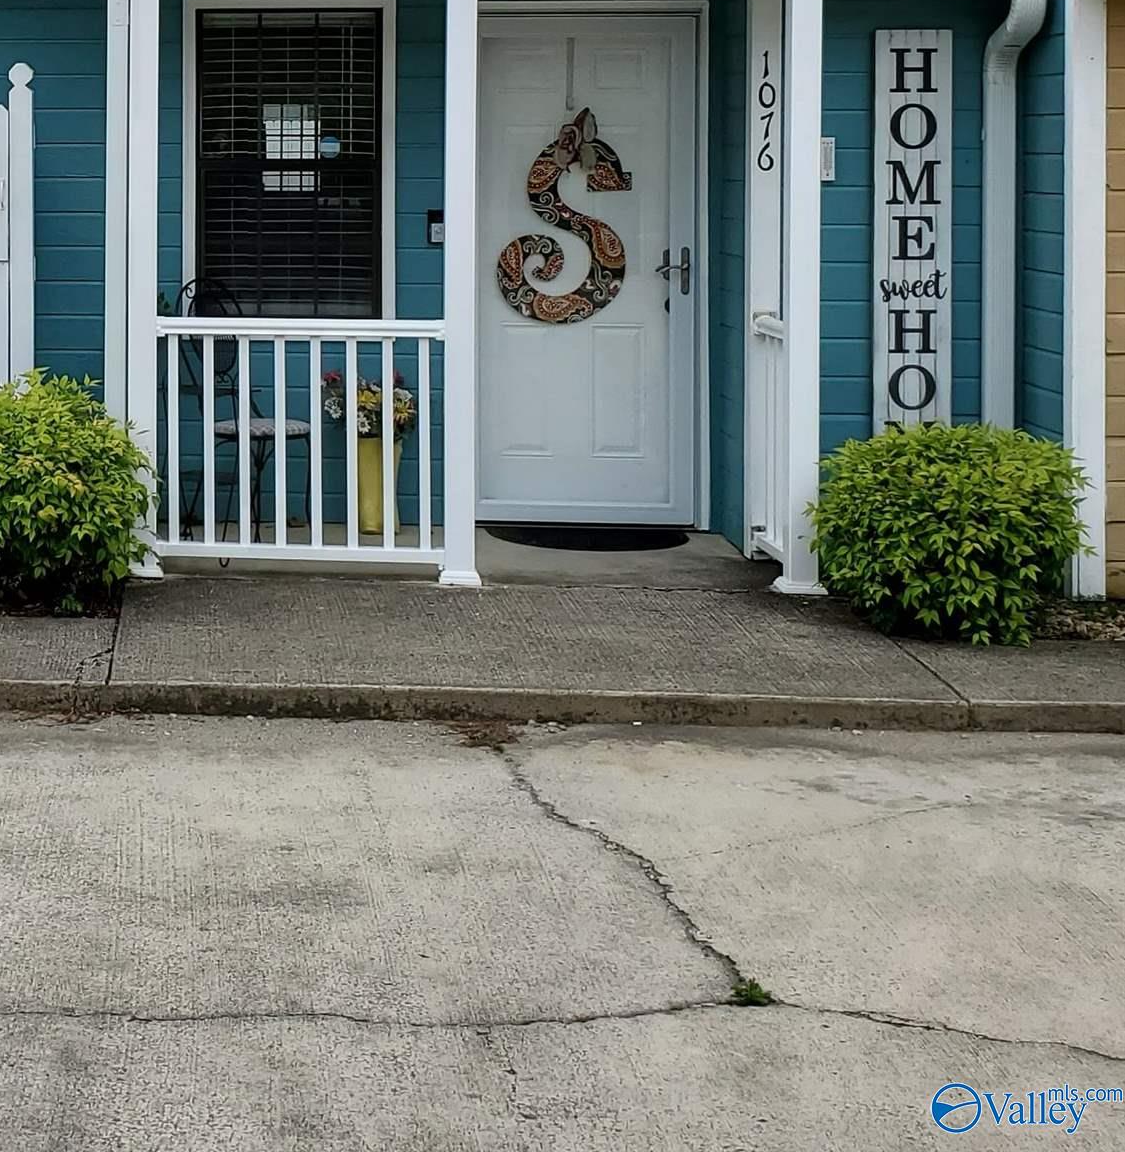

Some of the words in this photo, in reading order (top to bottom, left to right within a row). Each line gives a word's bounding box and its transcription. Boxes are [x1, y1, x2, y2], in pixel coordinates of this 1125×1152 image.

[757, 50, 776, 172] 1076
[885, 47, 942, 261] HOME
[880, 269, 948, 303] sweet
[884, 309, 940, 435] HO
